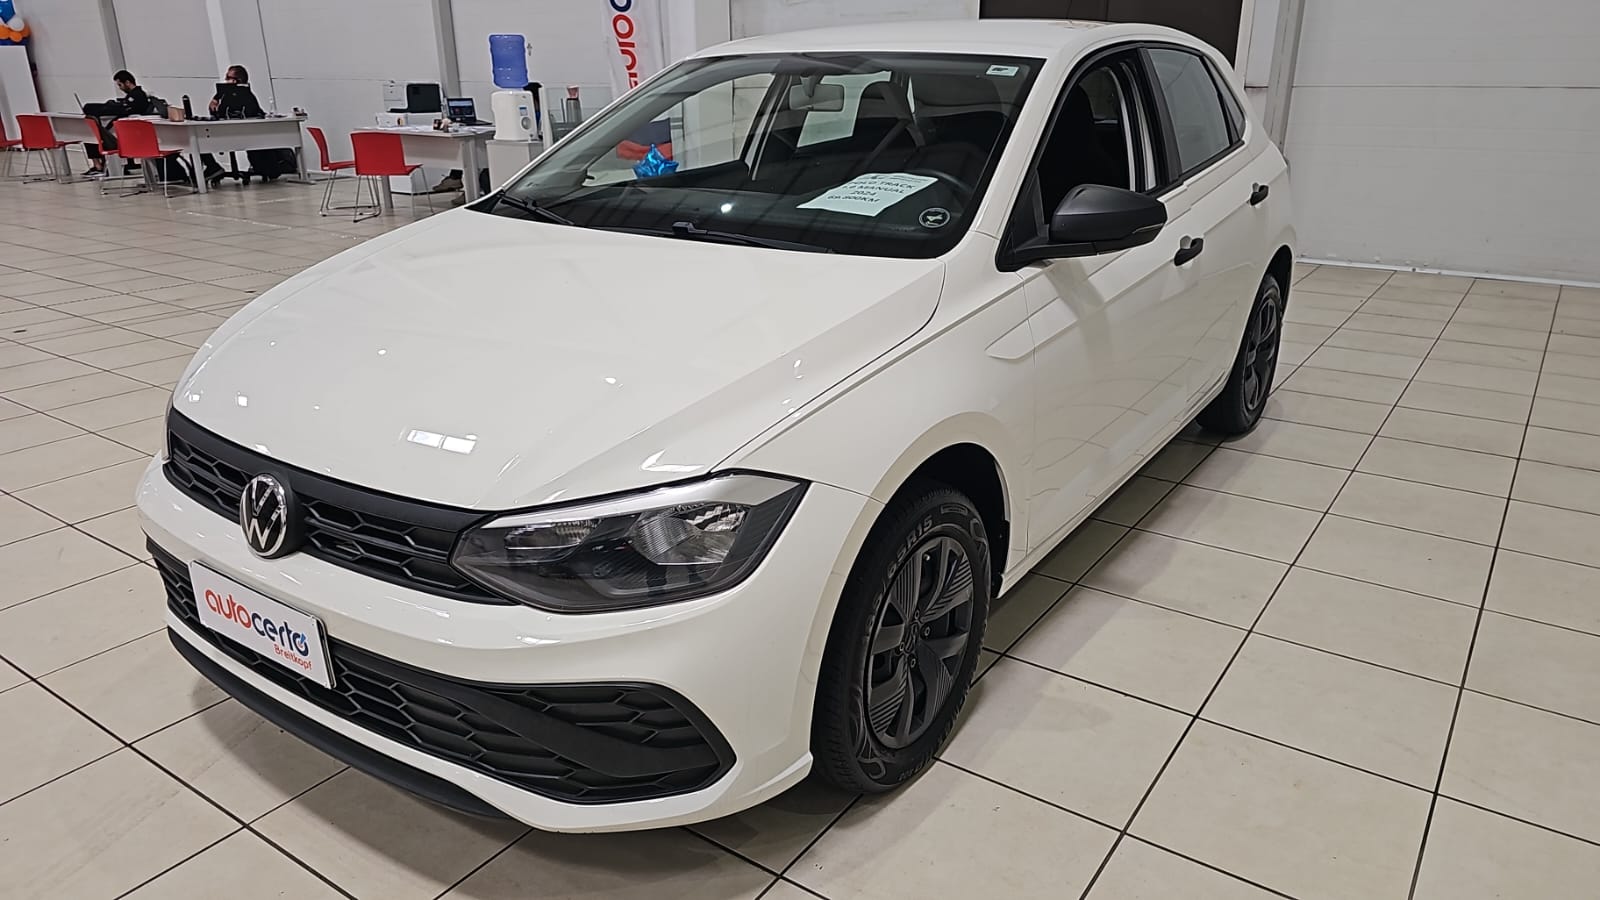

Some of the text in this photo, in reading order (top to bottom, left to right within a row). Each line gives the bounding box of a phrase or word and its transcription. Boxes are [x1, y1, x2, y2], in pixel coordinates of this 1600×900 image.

[857, 185, 905, 194] MANUAL
[879, 181, 916, 189] TRACK
[205, 589, 309, 656] autocerto
[273, 644, 312, 671] Breitkopf
